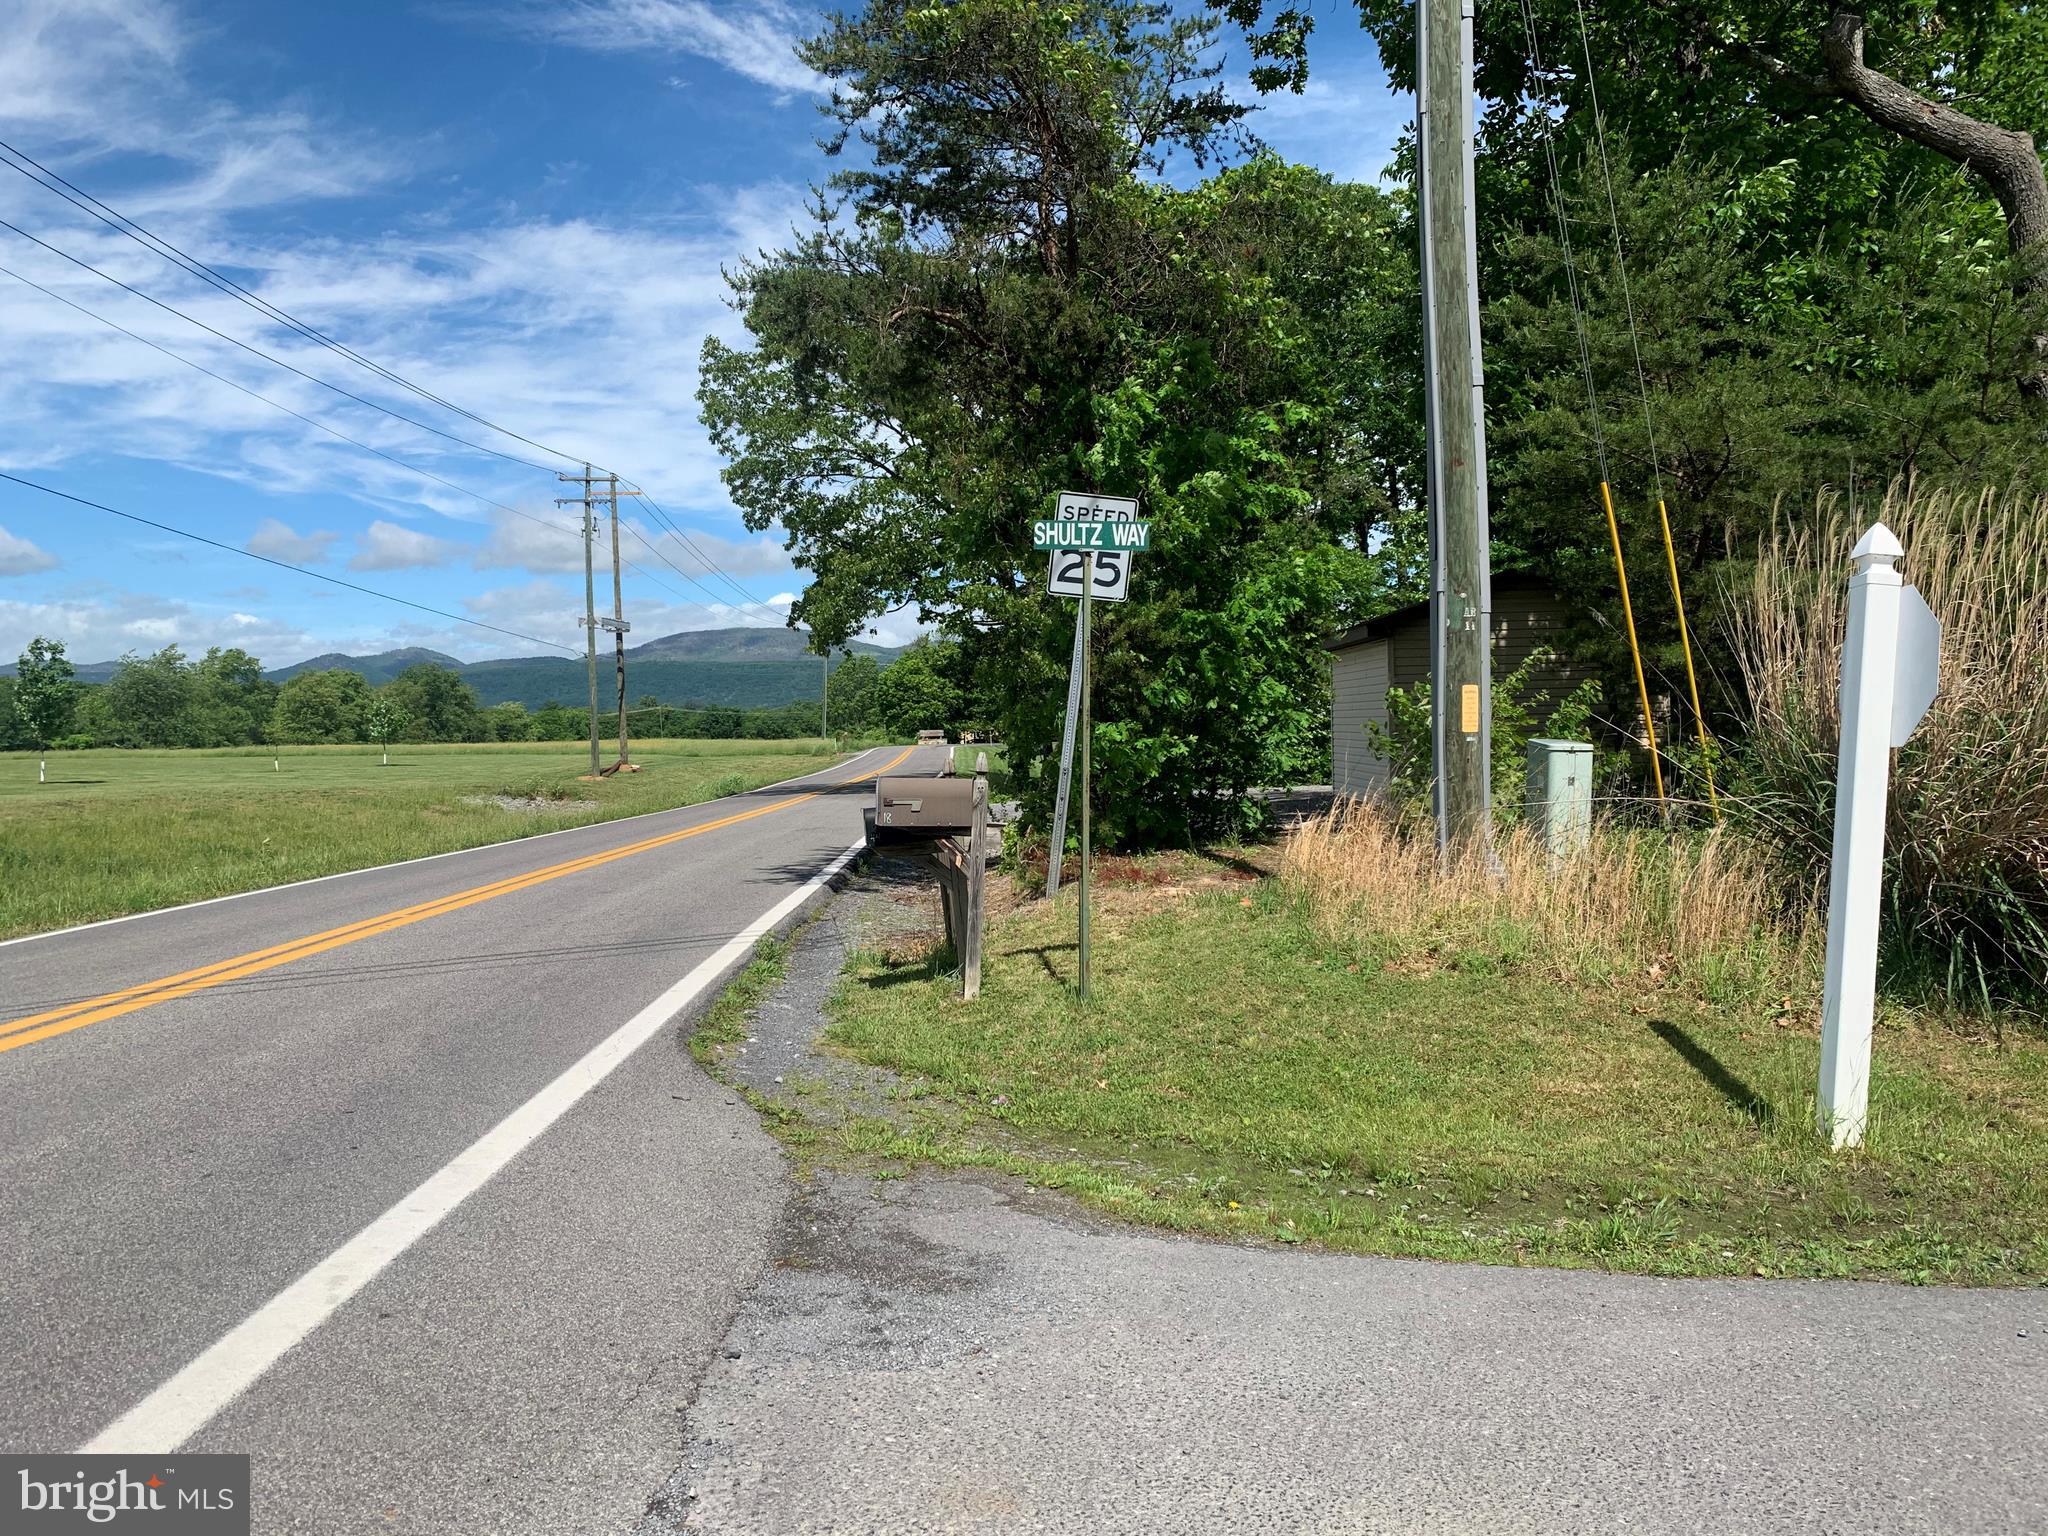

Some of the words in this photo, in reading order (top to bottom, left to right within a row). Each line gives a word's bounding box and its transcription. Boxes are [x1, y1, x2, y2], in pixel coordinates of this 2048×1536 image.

[1063, 505, 1129, 521] SPEED
[1033, 522, 1103, 545] SHULTZ
[1112, 523, 1149, 547] WAY
[1056, 550, 1121, 588] 25
